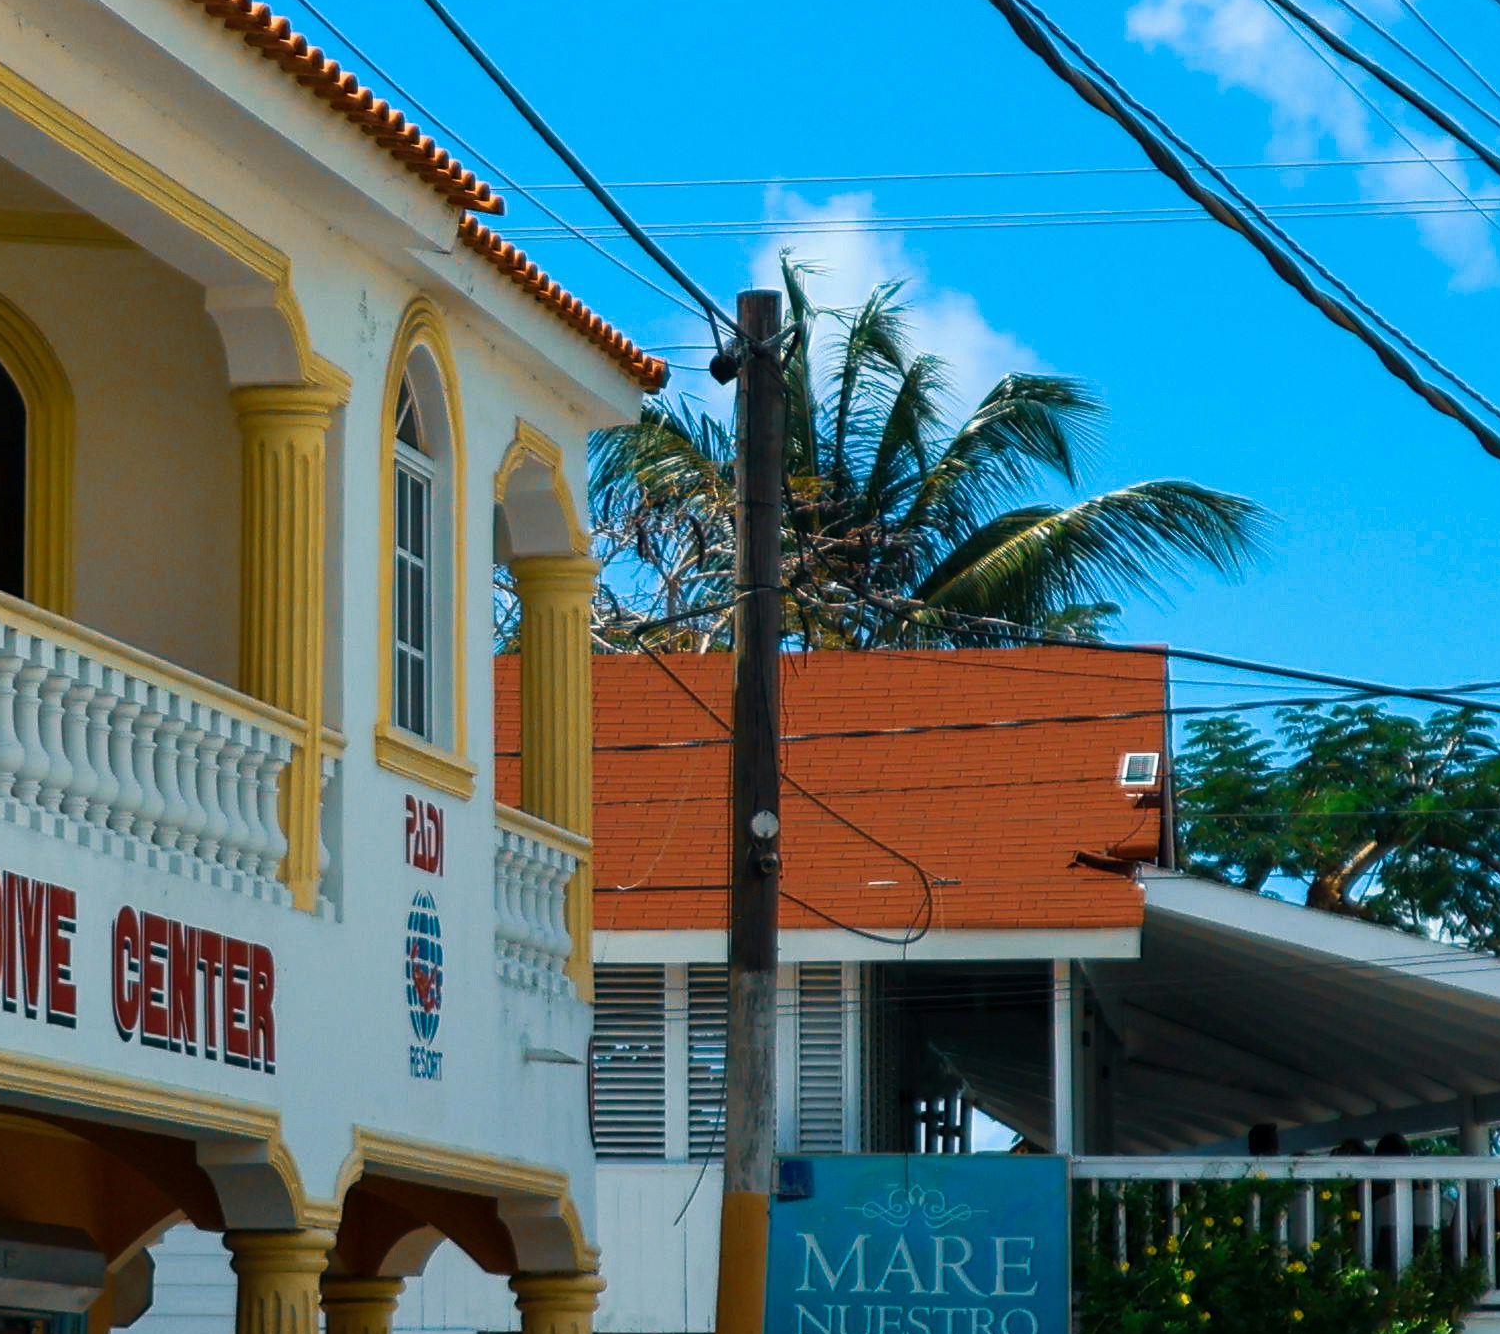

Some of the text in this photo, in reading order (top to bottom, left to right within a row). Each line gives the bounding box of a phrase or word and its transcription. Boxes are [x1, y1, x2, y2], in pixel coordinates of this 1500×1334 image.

[405, 793, 444, 877] PADI
[112, 905, 277, 1075] CENTER
[409, 1044, 443, 1082] RESORT
[796, 1232, 1039, 1298] MARE
